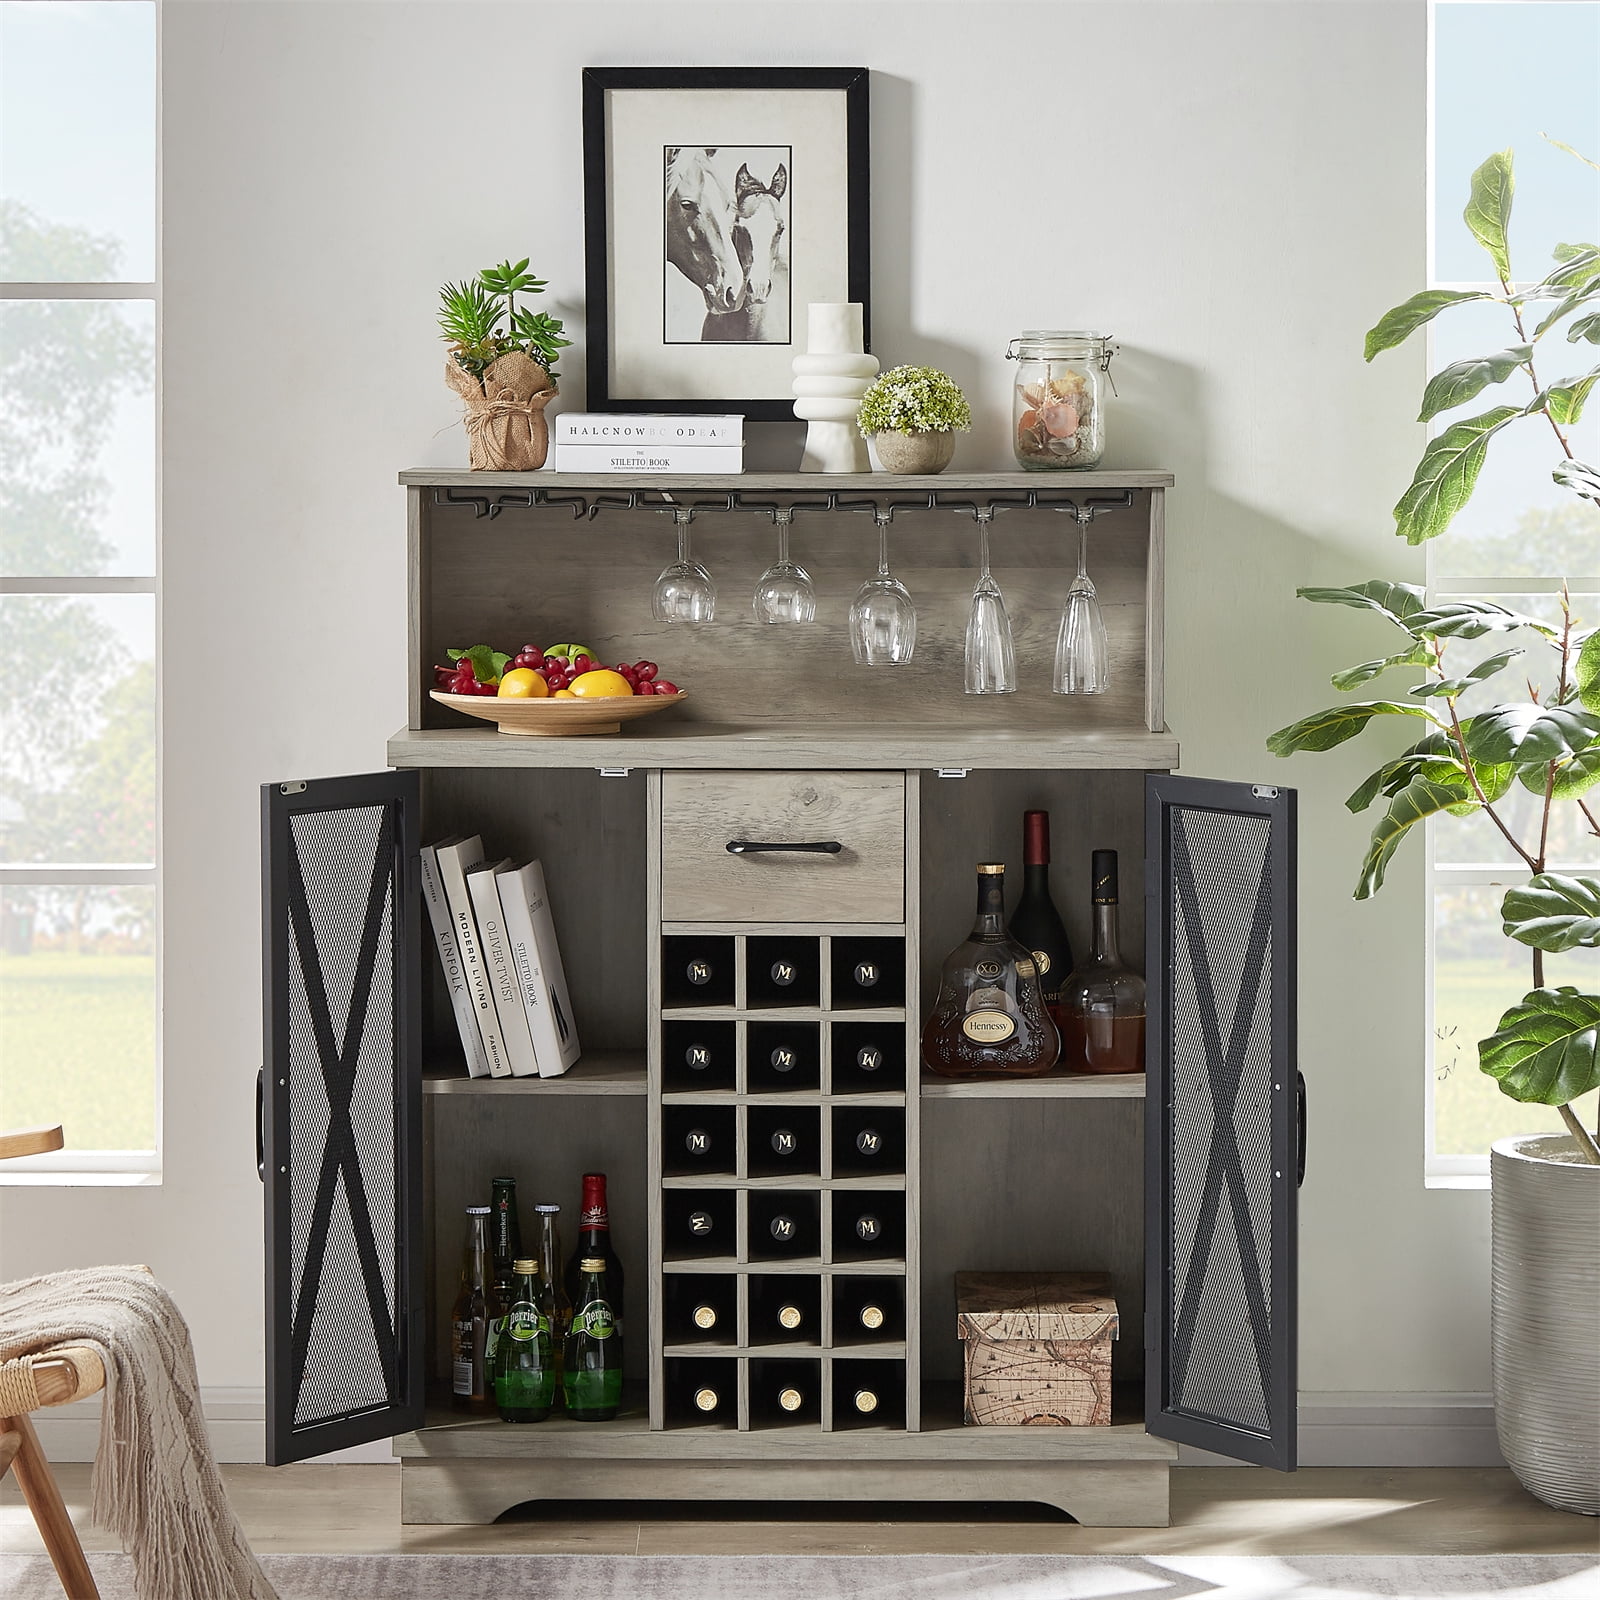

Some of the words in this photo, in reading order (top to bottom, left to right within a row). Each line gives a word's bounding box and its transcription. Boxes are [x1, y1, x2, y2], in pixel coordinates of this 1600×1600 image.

[610, 458, 646, 466] STILETTO
[649, 458, 670, 466] BOOK
[439, 931, 464, 994] KINFOLK
[458, 912, 477, 963] MODERN
[472, 969, 488, 1010] LIVING
[486, 920, 504, 965] OLIVER
[496, 965, 514, 1003] TWIST
[980, 964, 999, 974] XO
[516, 942, 533, 981] STILETTO
[526, 983, 538, 1007] BOOK
[692, 964, 708, 981] M
[775, 964, 792, 980] M
[860, 966, 875, 983] M
[969, 1020, 1009, 1032] Hennessy
[691, 1049, 707, 1065] M
[775, 1050, 792, 1066] M
[690, 1134, 705, 1151] M
[776, 1134, 792, 1151] M
[861, 1133, 878, 1149] M
[775, 1219, 792, 1235] M
[860, 1220, 875, 1237] M
[510, 1309, 538, 1330] perrier
[585, 1307, 612, 1331] perrier
